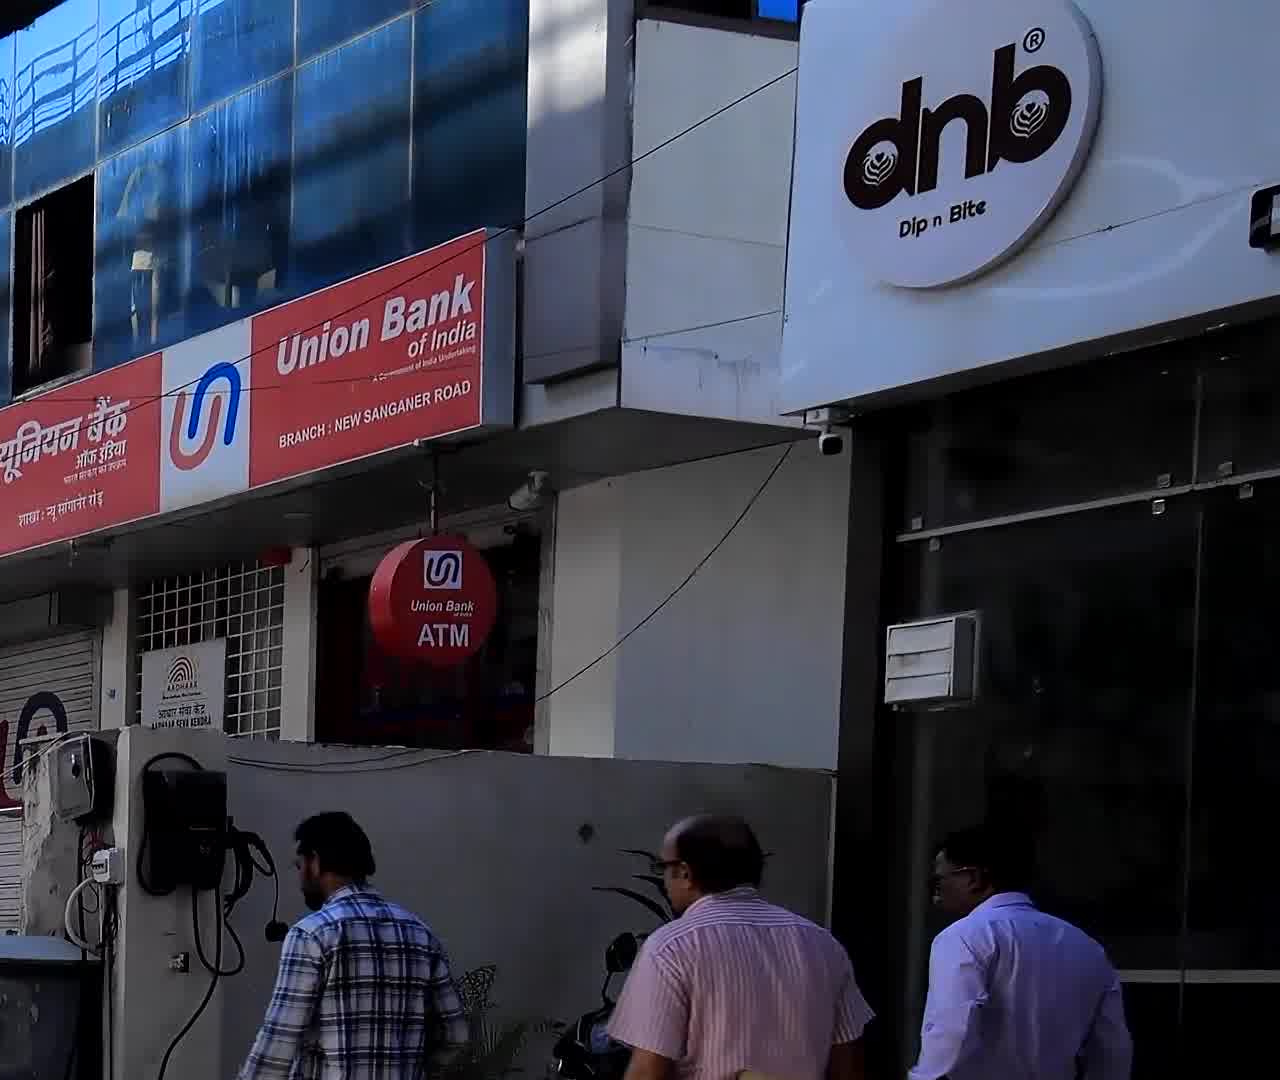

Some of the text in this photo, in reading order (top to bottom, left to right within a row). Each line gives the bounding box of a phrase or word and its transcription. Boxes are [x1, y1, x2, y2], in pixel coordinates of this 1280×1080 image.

[843, 42, 1072, 210] dnb
[899, 200, 986, 239] Dip n Bite
[277, 273, 475, 376] Union Bank
[407, 319, 477, 358] of India
[87, 396, 130, 441] बैंक
[279, 423, 326, 448] BRANCH
[335, 412, 362, 433] NEW
[363, 394, 431, 424] SANGANER
[434, 380, 471, 403] ROAD
[410, 599, 474, 612] Union Bank
[417, 623, 469, 648] ATM
